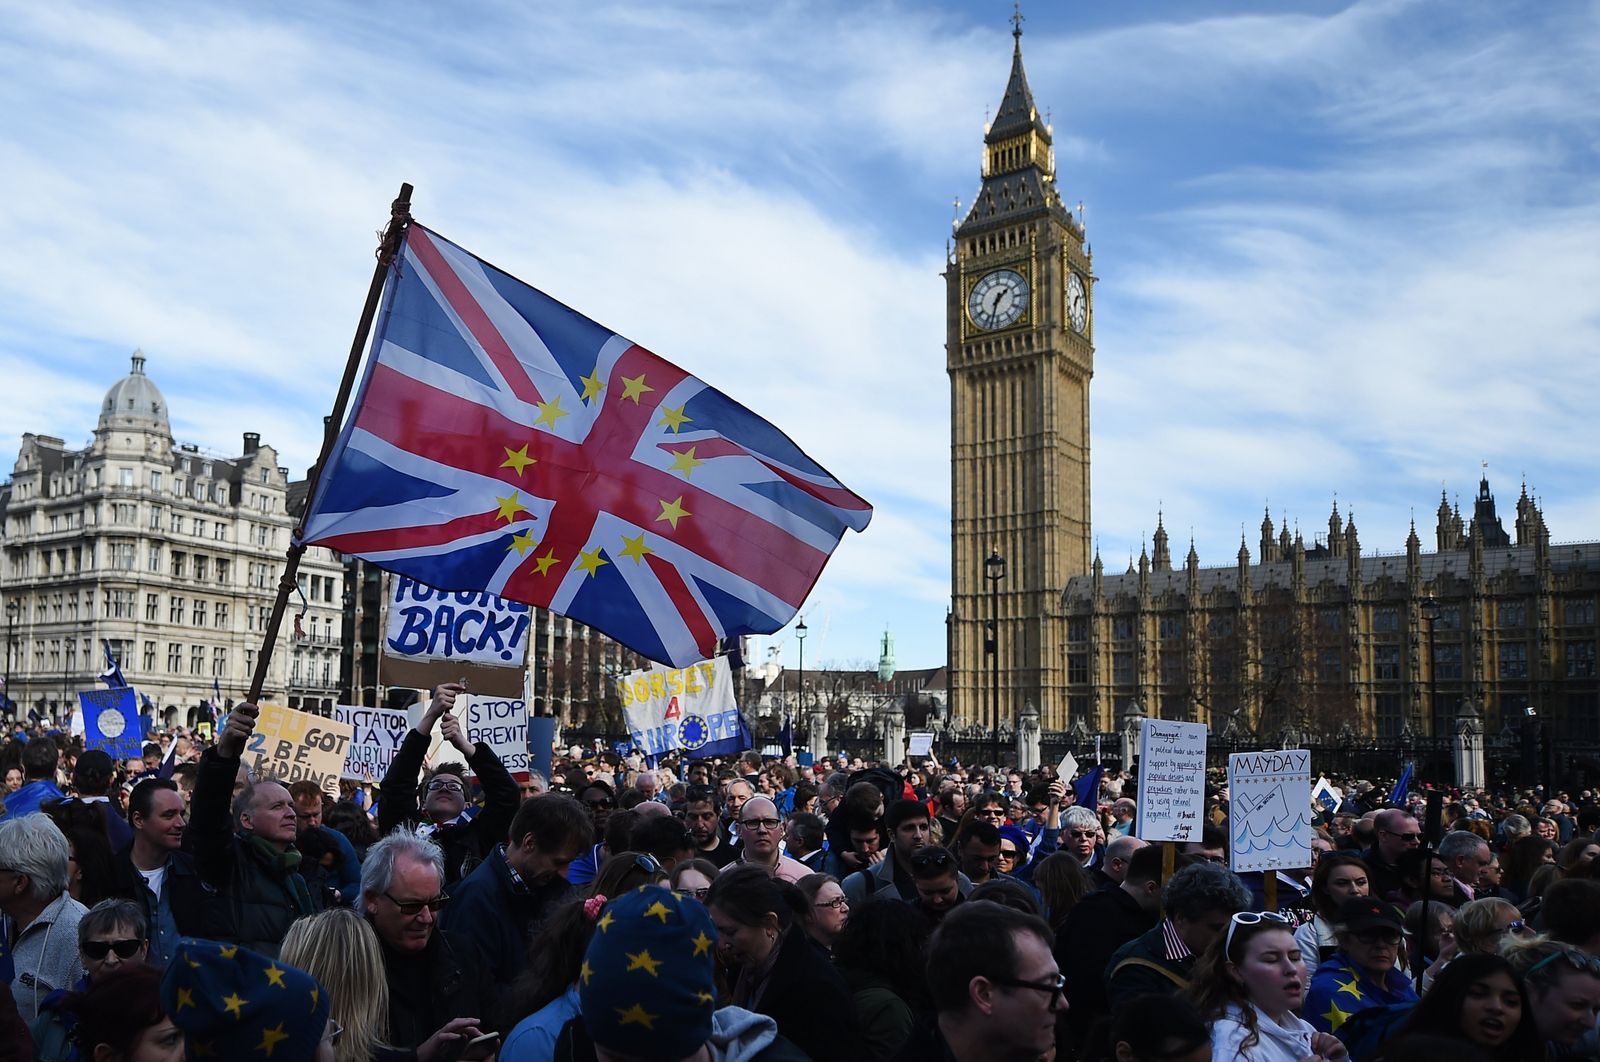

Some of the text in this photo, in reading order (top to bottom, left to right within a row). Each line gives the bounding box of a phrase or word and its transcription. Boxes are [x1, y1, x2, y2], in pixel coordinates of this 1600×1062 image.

[388, 605, 529, 660] BACK!
[617, 663, 714, 707] DORSET
[469, 701, 526, 723] STOP
[664, 697, 680, 720] 4
[256, 704, 350, 755] EU GOT
[335, 709, 407, 730] DICTATOR
[468, 725, 527, 744] BREXIT
[247, 733, 311, 764] 2 BE
[364, 746, 380, 764] BY
[499, 753, 528, 768] ESS
[1234, 754, 1308, 775] MAYDAY
[1147, 795, 1154, 810] by
